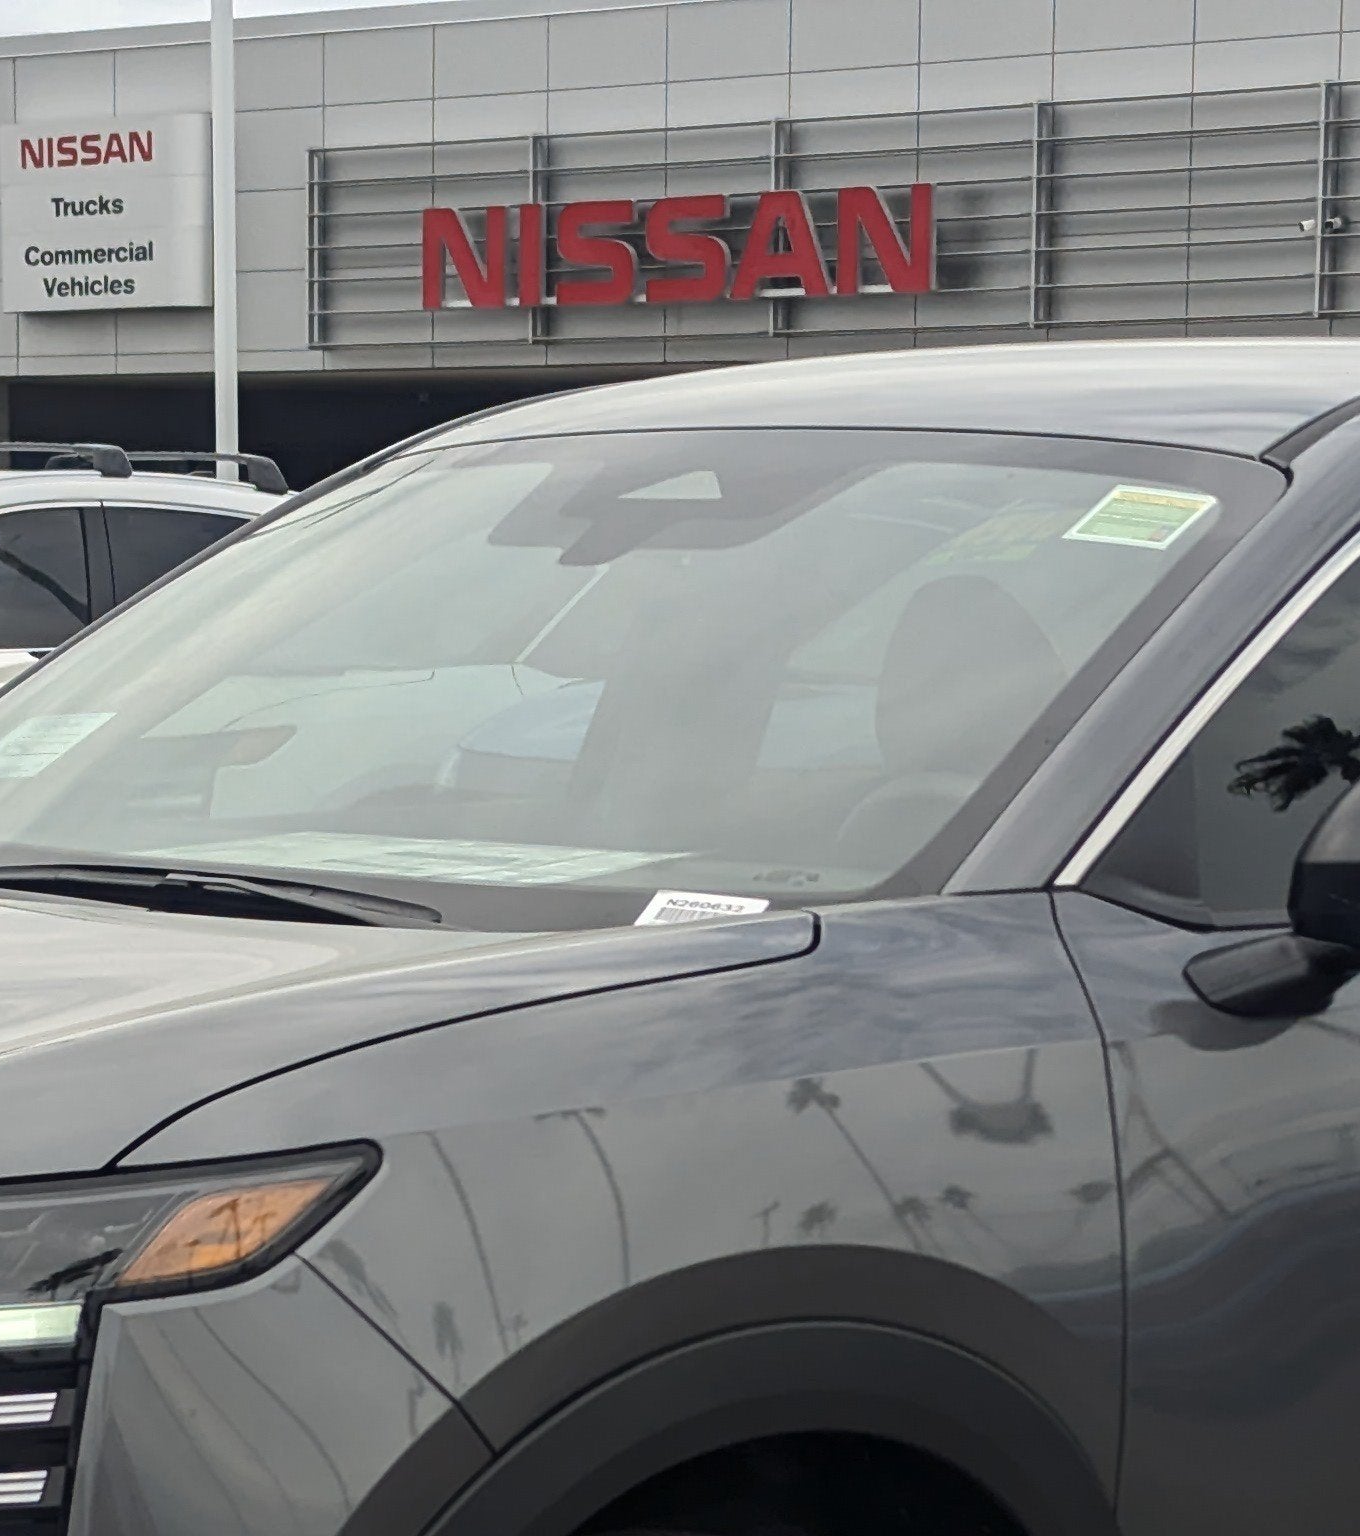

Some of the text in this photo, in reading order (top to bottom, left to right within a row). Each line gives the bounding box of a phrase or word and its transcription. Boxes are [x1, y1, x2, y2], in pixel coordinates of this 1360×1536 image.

[20, 130, 153, 169] NISSAN
[51, 195, 124, 217] Trucks
[24, 241, 154, 266] Commercial
[422, 183, 936, 310] NISSAN
[43, 276, 137, 297] Vehicles
